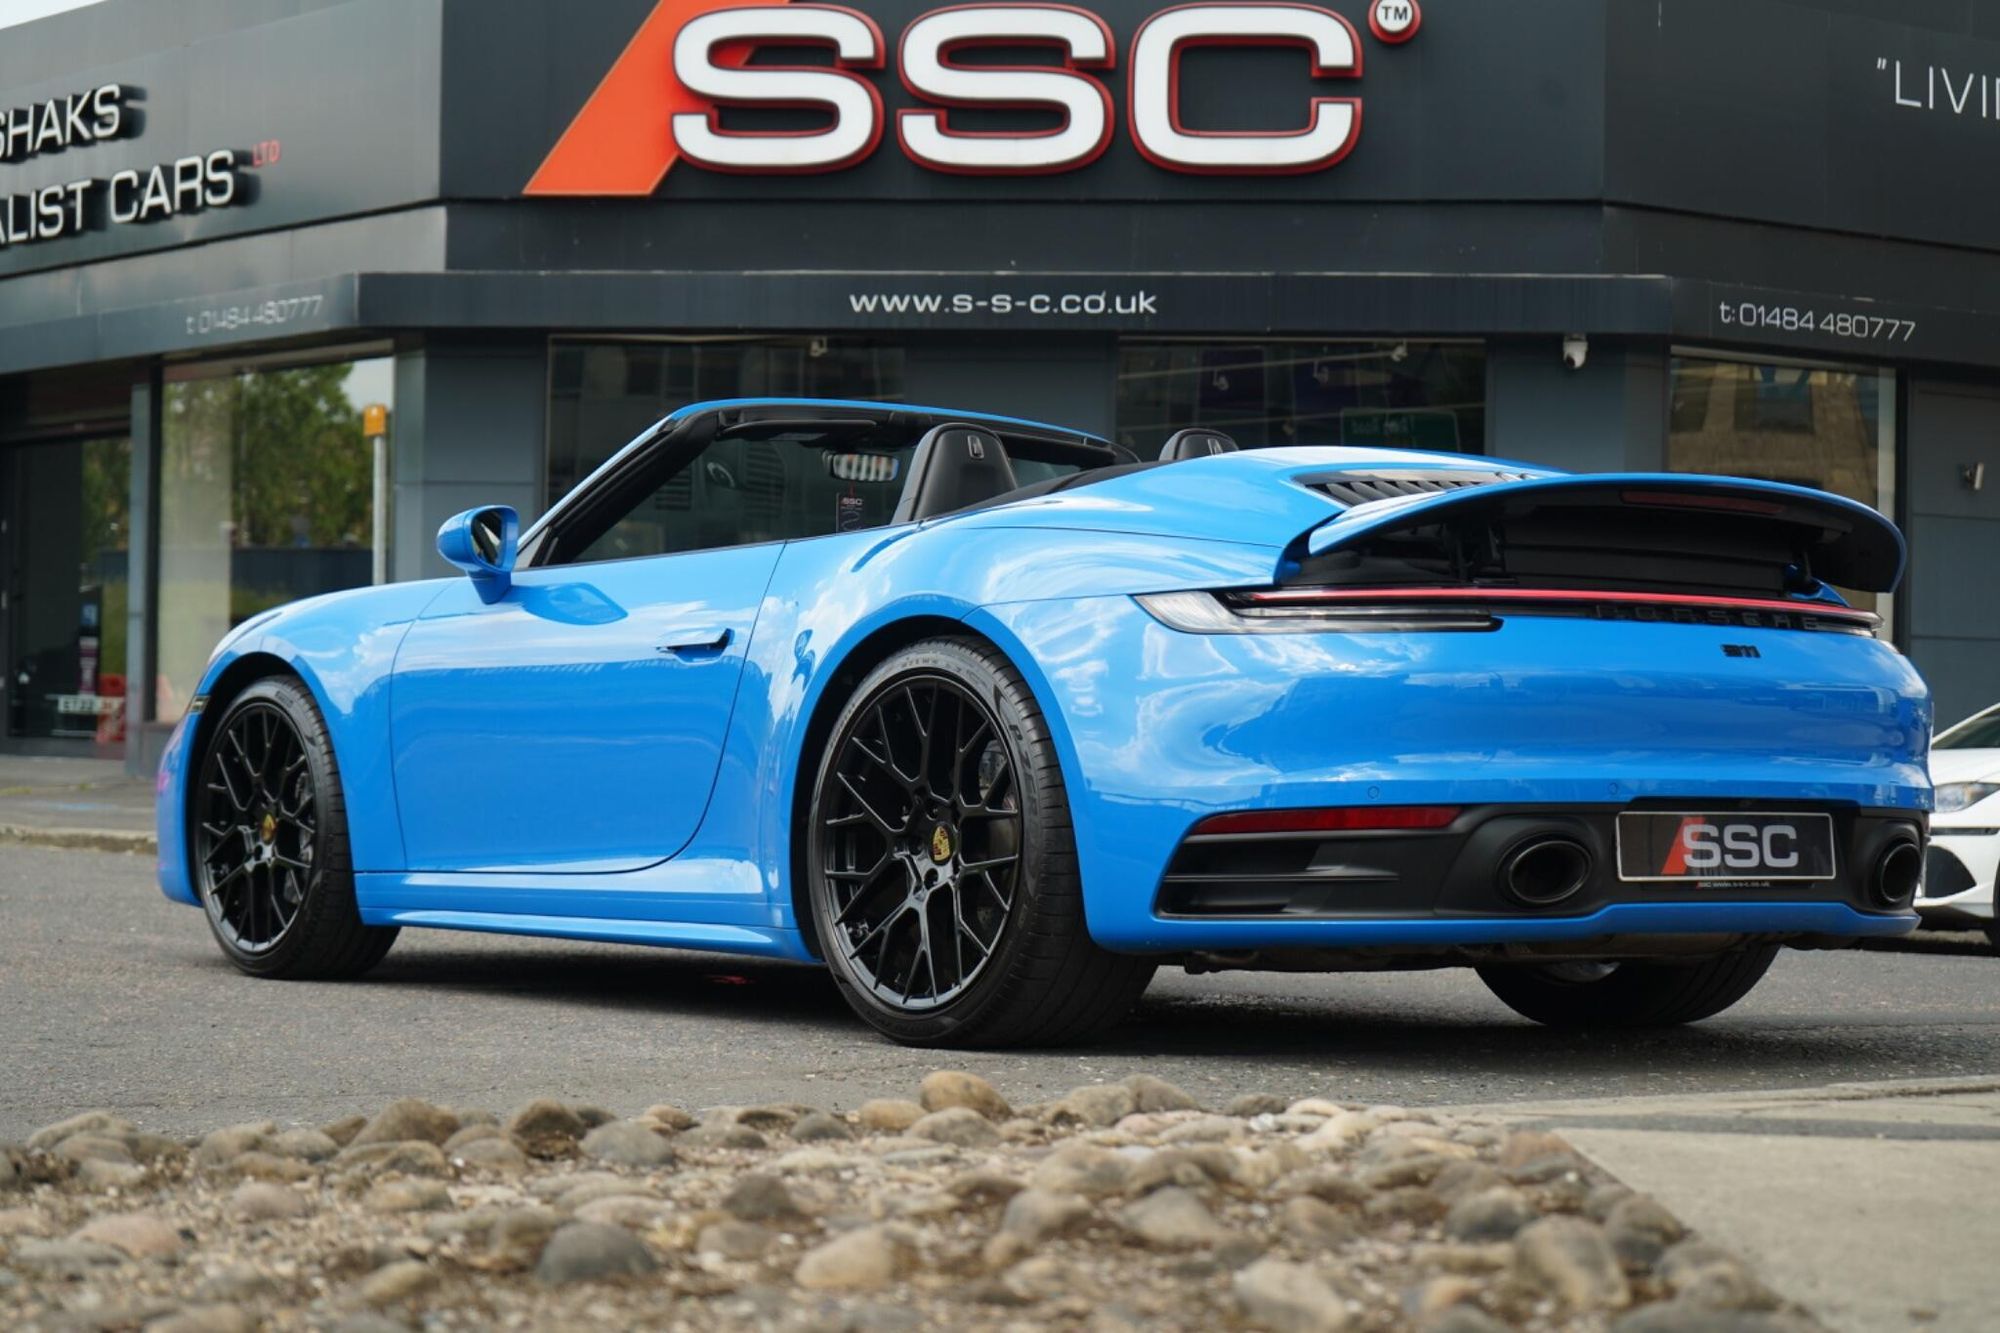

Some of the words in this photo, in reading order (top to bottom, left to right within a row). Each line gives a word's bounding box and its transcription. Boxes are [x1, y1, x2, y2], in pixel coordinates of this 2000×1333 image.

[1381, 6, 1408, 20] TM
[671, 2, 1363, 175] SSC
[0, 84, 120, 158] HAKS
[0, 179, 92, 244] LIST
[110, 149, 234, 223] CARS
[252, 139, 280, 167] LTD
[849, 291, 1156, 314] www.s-s-c.co.uk
[1819, 313, 1916, 341] 480777
[1682, 824, 1798, 867] SSC
